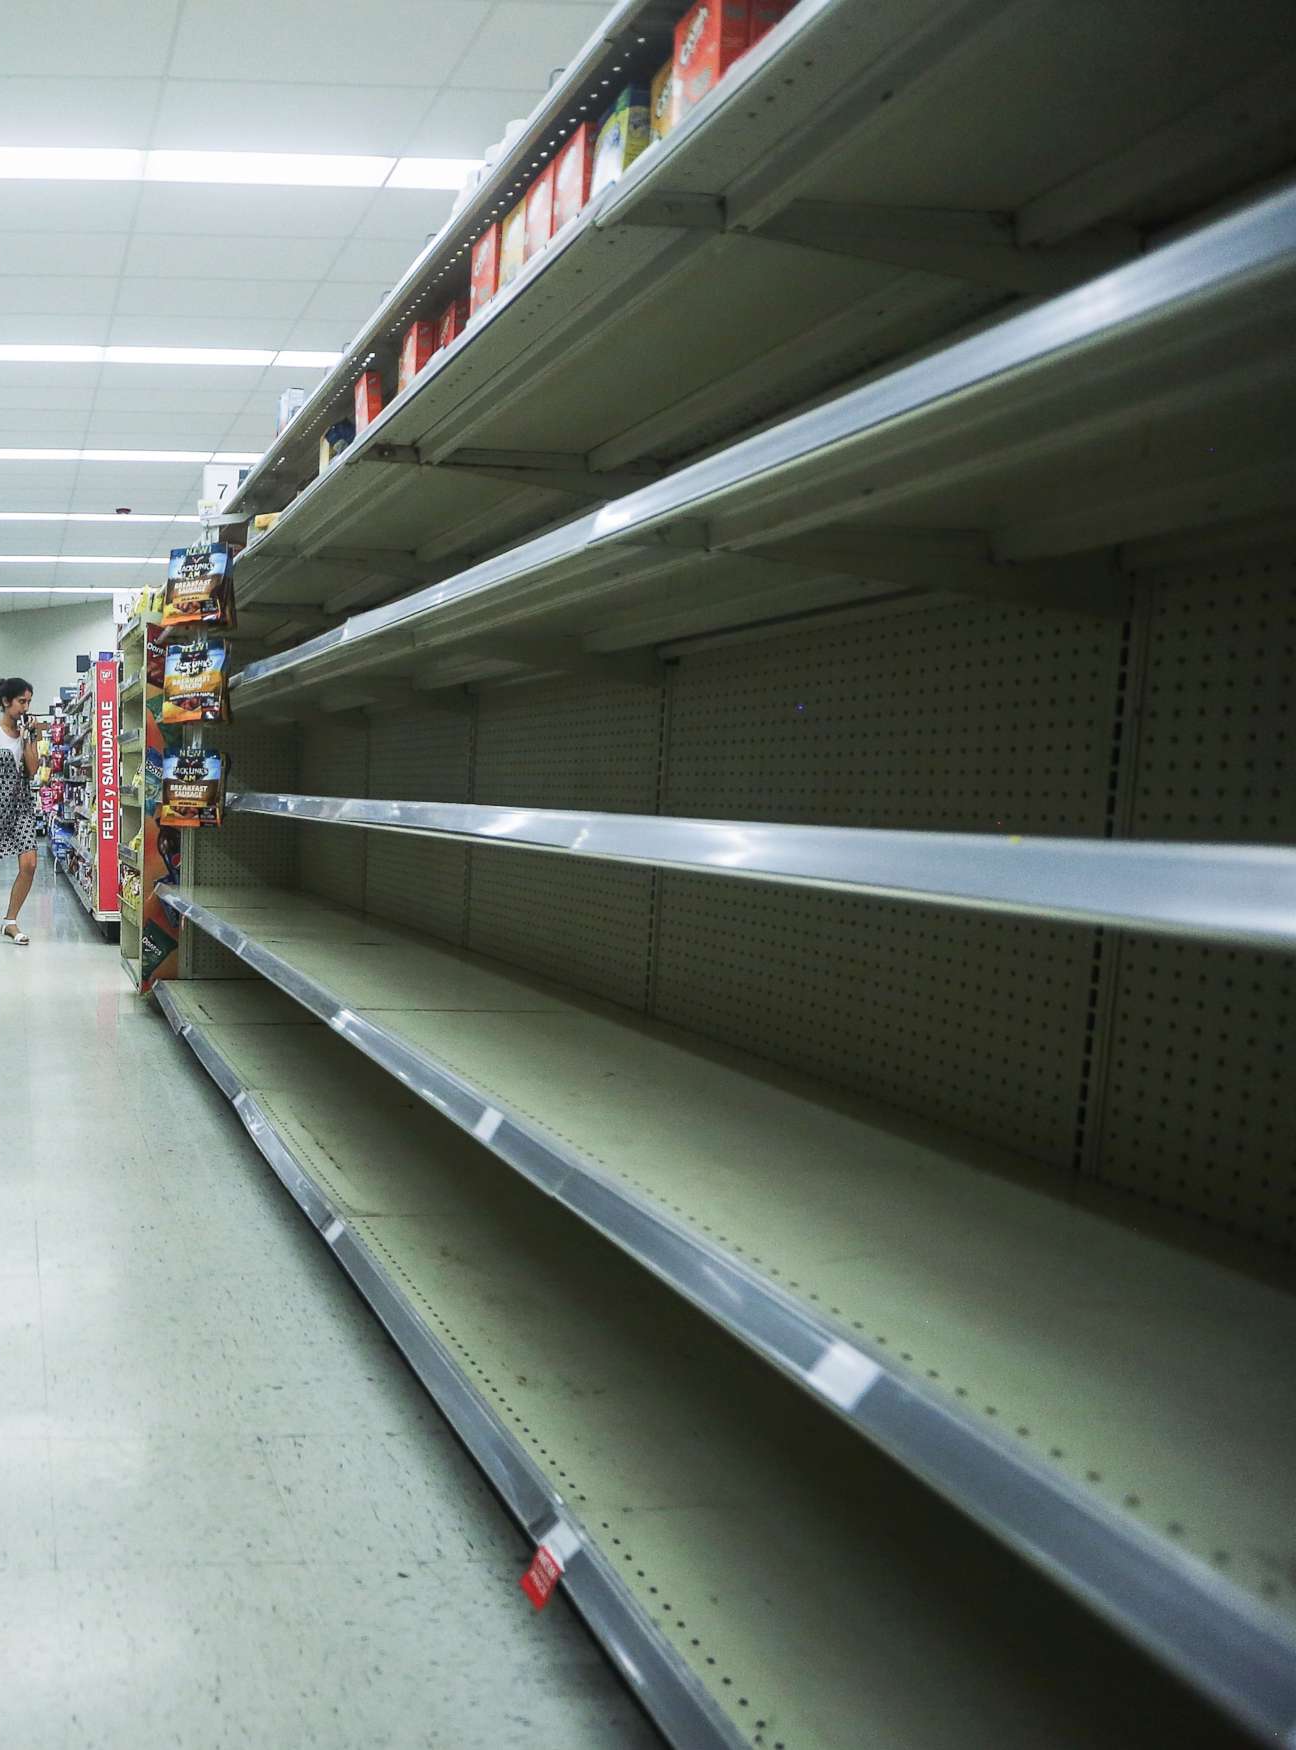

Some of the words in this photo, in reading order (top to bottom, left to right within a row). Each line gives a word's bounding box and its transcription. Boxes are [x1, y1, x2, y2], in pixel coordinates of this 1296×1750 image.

[217, 483, 228, 500] 7
[119, 603, 130, 614] 16
[102, 701, 114, 785] SALUDABLE
[105, 788, 116, 796] y
[170, 784, 209, 792] BREAKFAST
[103, 800, 114, 840] FELIZ
